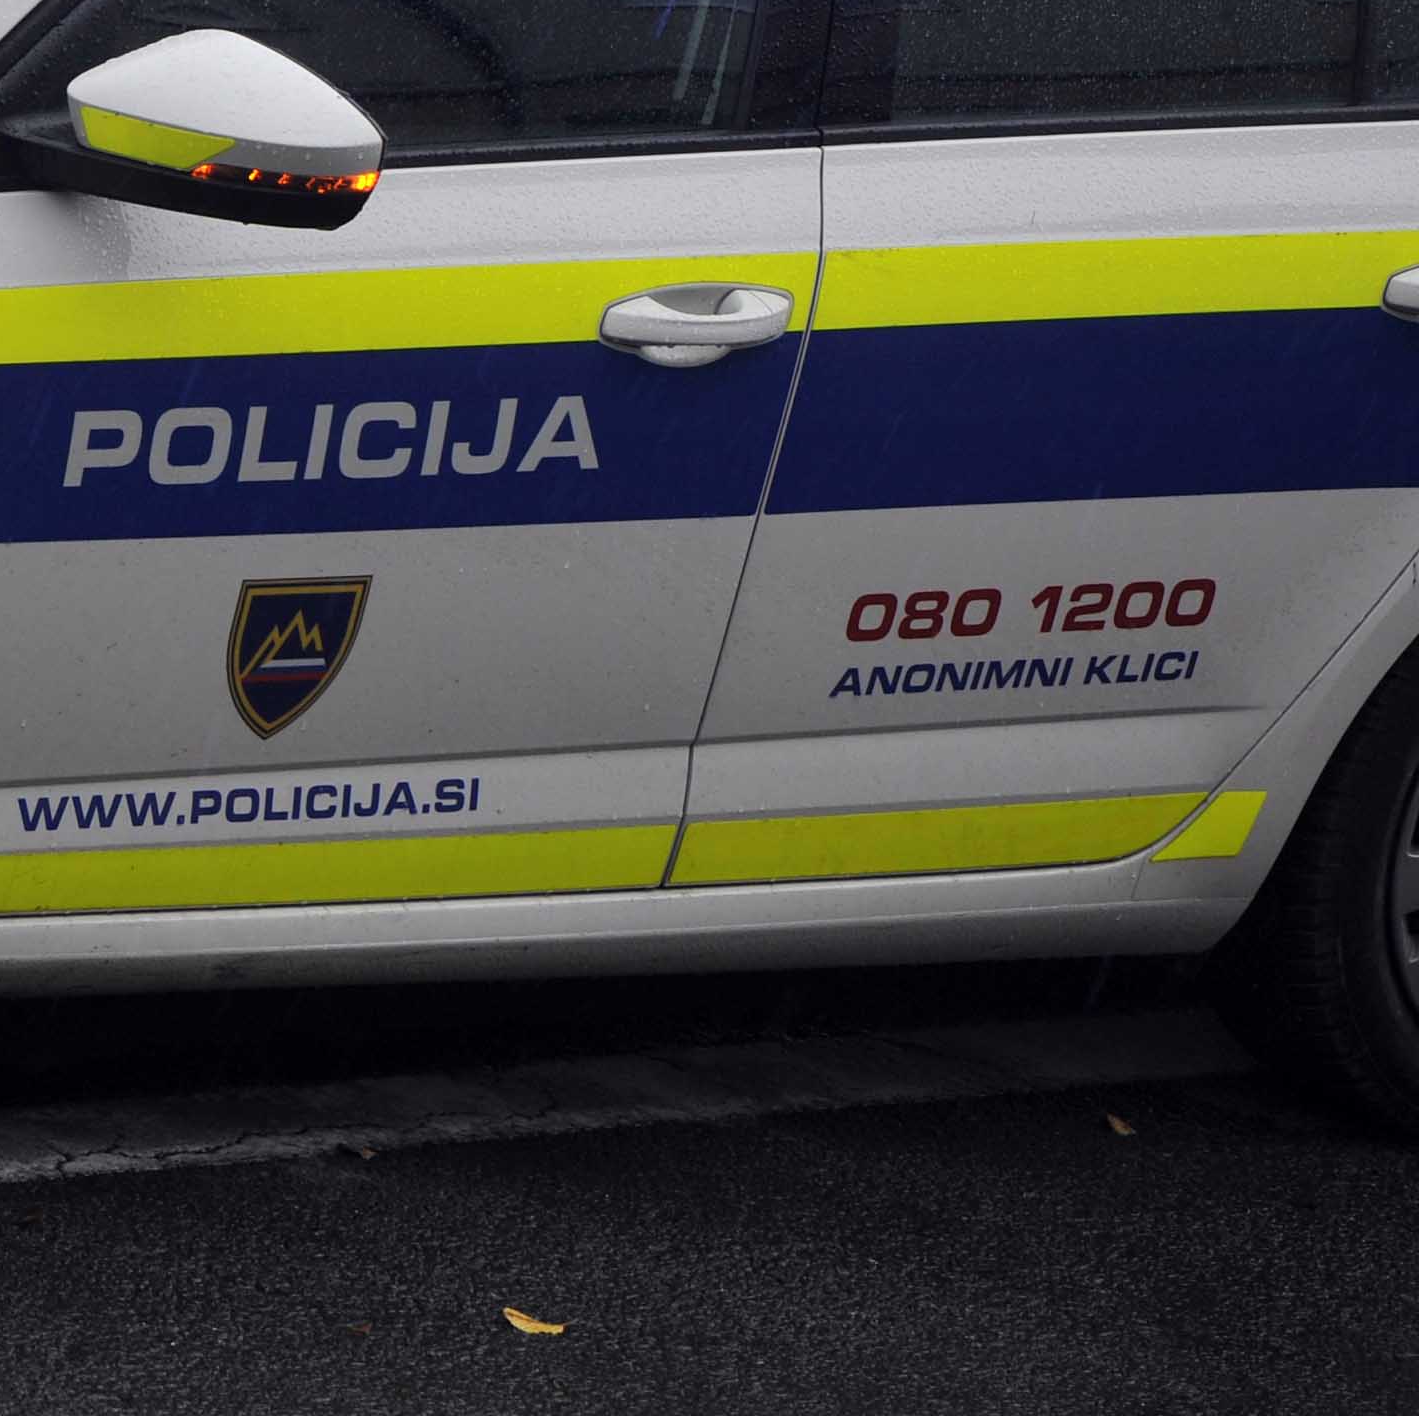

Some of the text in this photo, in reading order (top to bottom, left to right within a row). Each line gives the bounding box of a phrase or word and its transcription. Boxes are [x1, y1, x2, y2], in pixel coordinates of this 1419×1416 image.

[63, 395, 599, 487] POLICIJA
[846, 578, 1216, 642] 080 1200
[829, 650, 1199, 699] ANONIMNI KLICI
[18, 778, 480, 831] WWW.POLICIJA.SI
